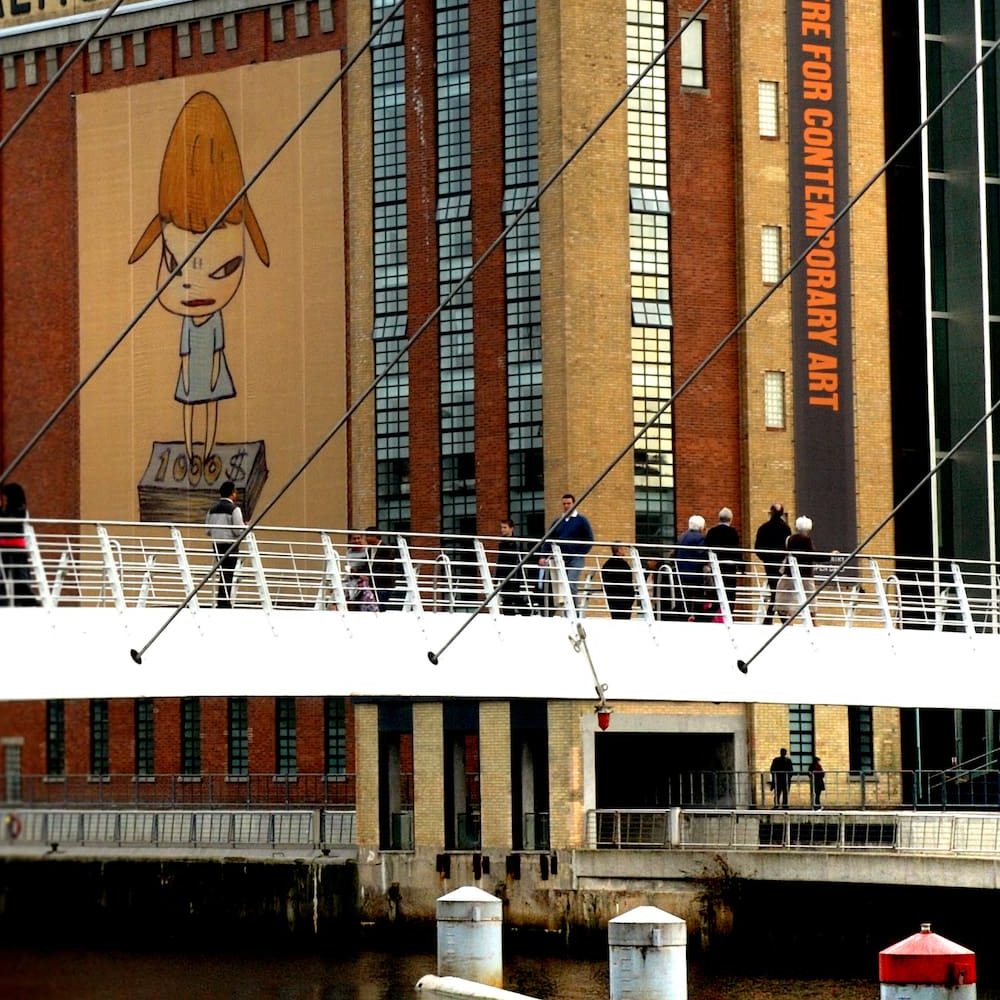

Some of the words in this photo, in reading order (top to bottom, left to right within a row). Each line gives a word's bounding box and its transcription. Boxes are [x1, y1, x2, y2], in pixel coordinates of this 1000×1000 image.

[802, 43, 833, 101] FOR
[803, 108, 837, 346] CONTEMPORARY
[807, 352, 839, 411] ART
